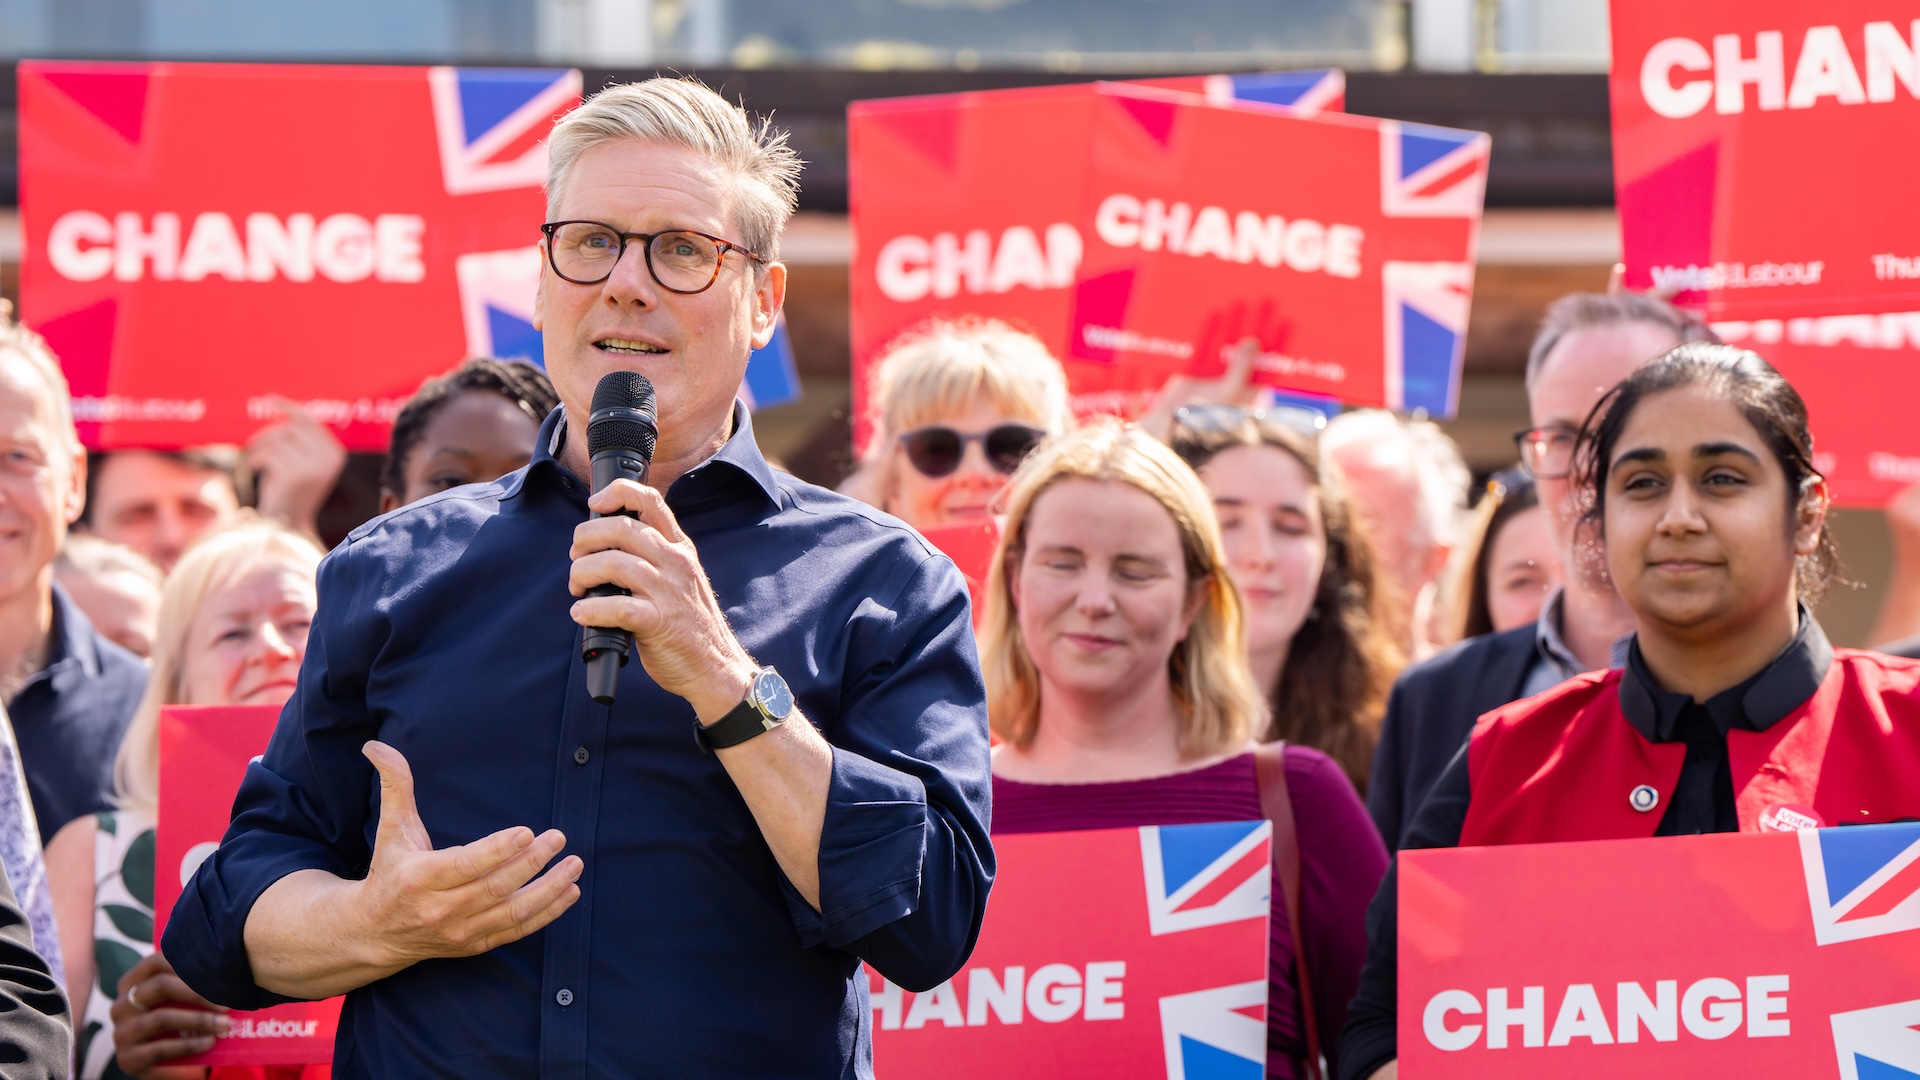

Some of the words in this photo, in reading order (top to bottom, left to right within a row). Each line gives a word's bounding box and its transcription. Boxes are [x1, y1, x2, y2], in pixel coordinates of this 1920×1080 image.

[47, 210, 425, 283] CHANGE
[1097, 194, 1364, 279] CHANGE
[1739, 261, 1824, 288] Labour
[246, 1018, 319, 1038] Labour
[866, 961, 1126, 1030] HANGE
[1422, 974, 1790, 1051] CHANGE
